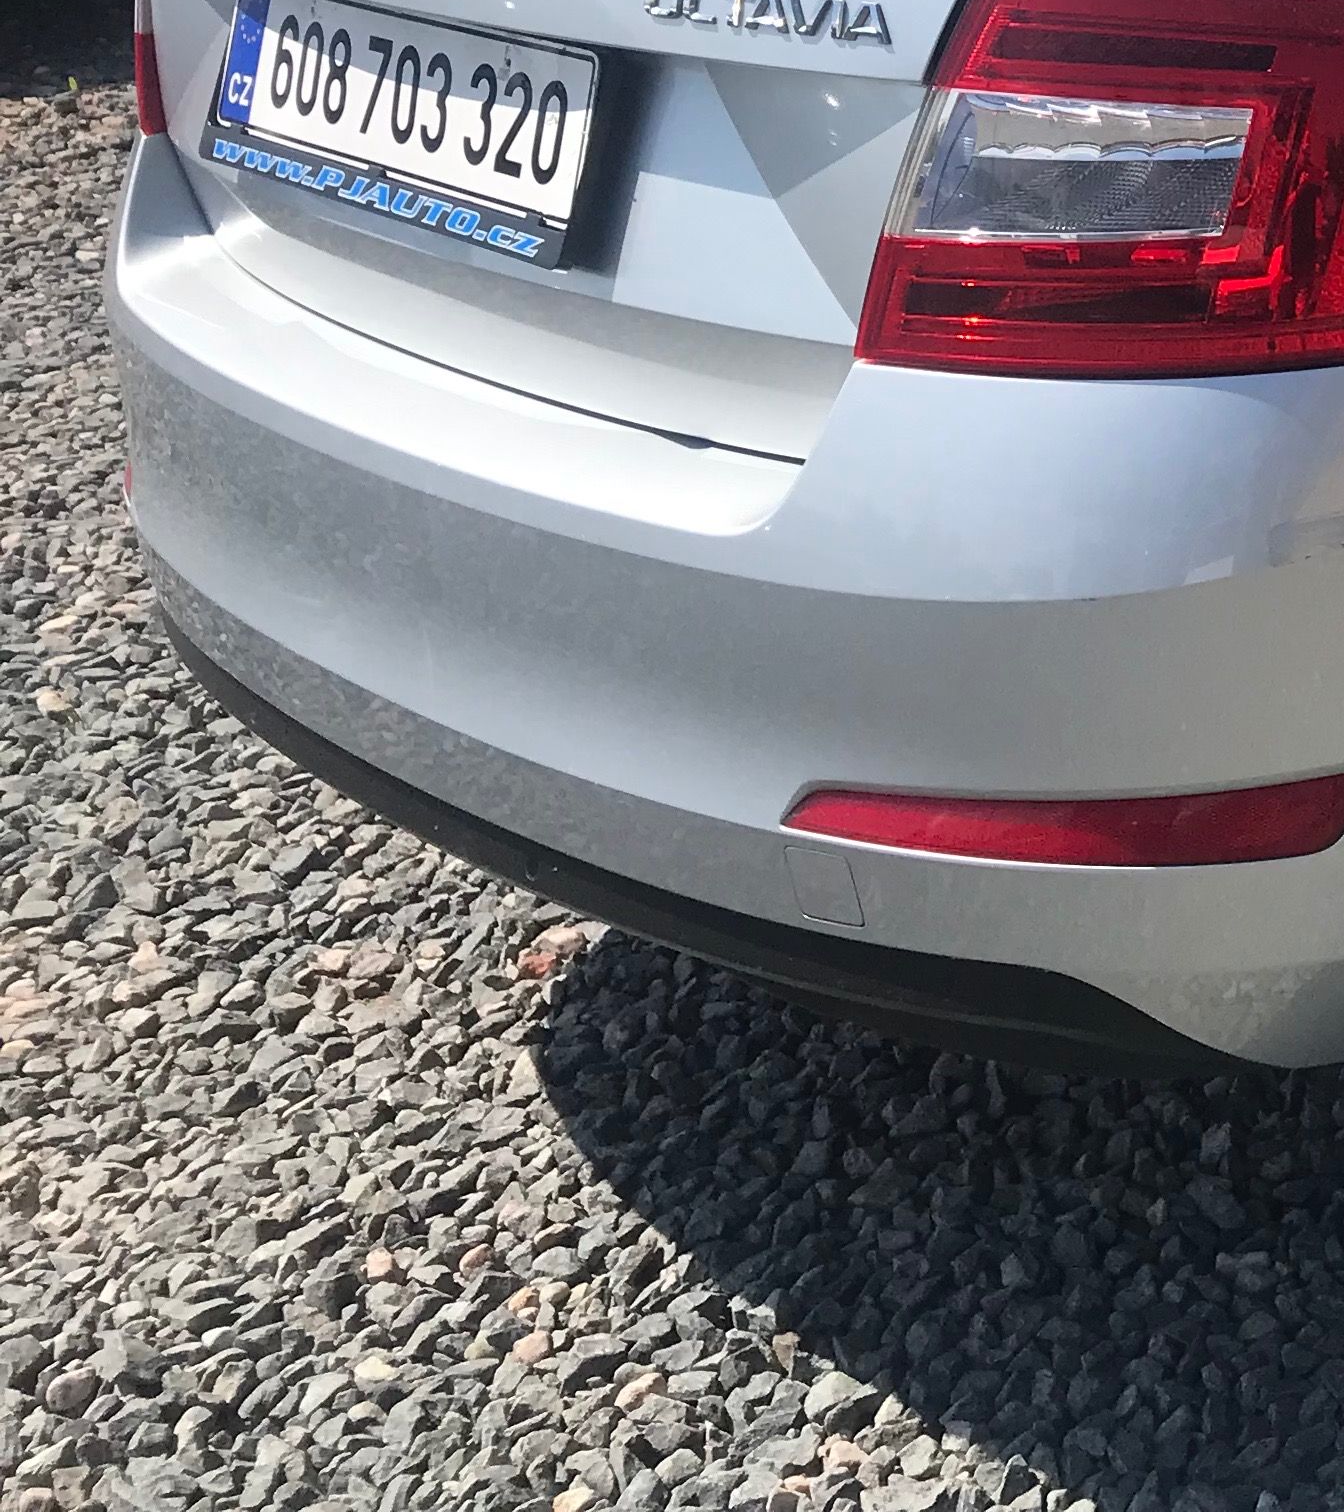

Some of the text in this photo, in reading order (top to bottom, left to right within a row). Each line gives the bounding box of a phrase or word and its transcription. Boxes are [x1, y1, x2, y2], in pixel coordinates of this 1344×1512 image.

[227, 73, 254, 108] CZ
[271, 15, 569, 186] 608 703 320
